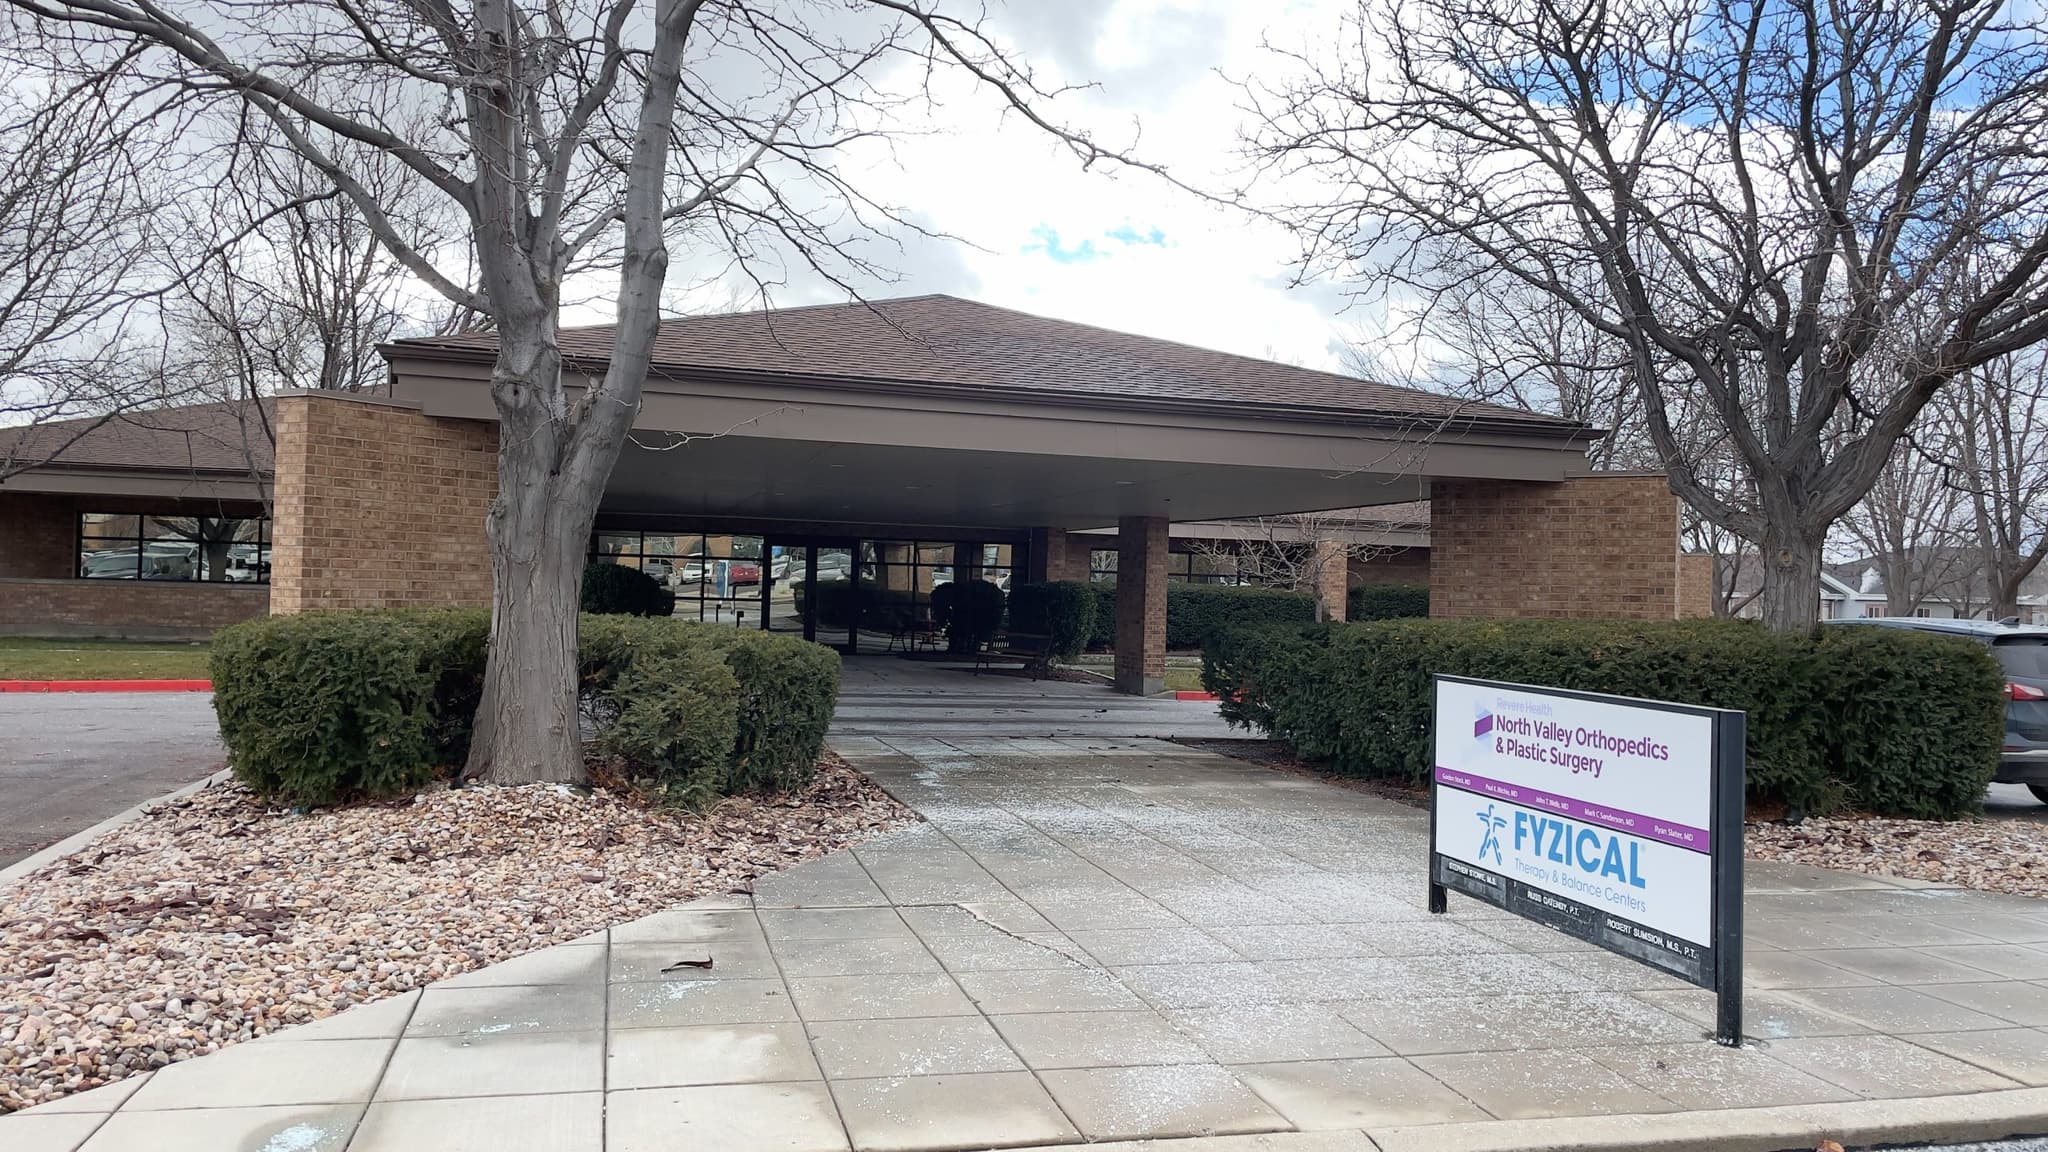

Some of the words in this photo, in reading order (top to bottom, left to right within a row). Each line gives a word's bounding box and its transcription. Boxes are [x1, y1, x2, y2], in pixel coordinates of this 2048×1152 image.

[1525, 701, 1553, 716] Health
[1496, 714, 1531, 737] North
[1533, 720, 1573, 748] Valley
[1575, 727, 1669, 761] Orthopedics
[1496, 736, 1504, 754] &
[1506, 738, 1547, 763] Plastic
[1549, 746, 1603, 778] Surgery
[1561, 802, 1569, 810] MD
[1584, 807, 1596, 817] Mark
[1625, 818, 1635, 827] MD
[1654, 825, 1667, 835] Ryan
[1683, 832, 1694, 841] MD
[1514, 810, 1646, 889] FYZICAL
[1515, 857, 1550, 885] Therapy
[1552, 869, 1560, 883] &
[1561, 875, 1601, 899] Balance
[1604, 885, 1647, 913] Centers
[1606, 918, 1632, 934] ROBERT
